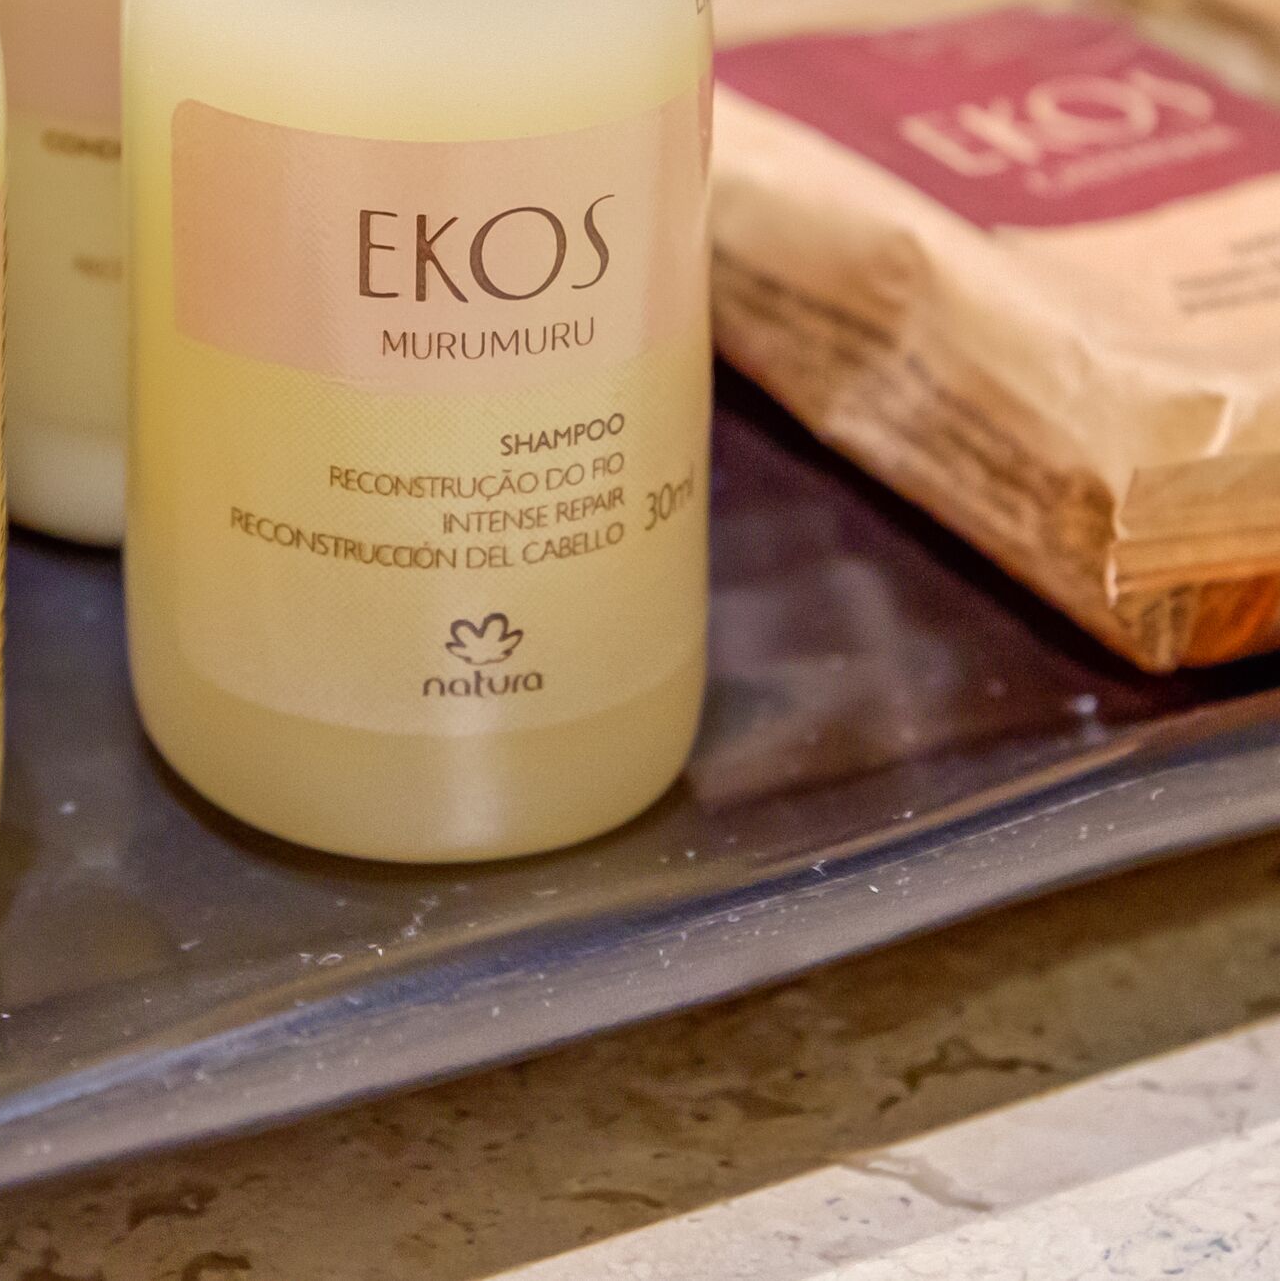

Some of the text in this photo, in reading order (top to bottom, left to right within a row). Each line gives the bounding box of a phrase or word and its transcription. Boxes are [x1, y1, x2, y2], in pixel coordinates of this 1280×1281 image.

[900, 70, 1215, 176] EKOS
[357, 194, 614, 303] EKOS
[381, 317, 594, 360] MURUMURU
[500, 413, 625, 456] SHAMPOO
[329, 452, 625, 502] RECONSTRUÇÃO DO FIO
[443, 487, 625, 534] INTENSE REPAIR
[230, 506, 624, 569] RECONSTRUCCIÓN DEL CABELLO
[422, 670, 543, 699] natura
